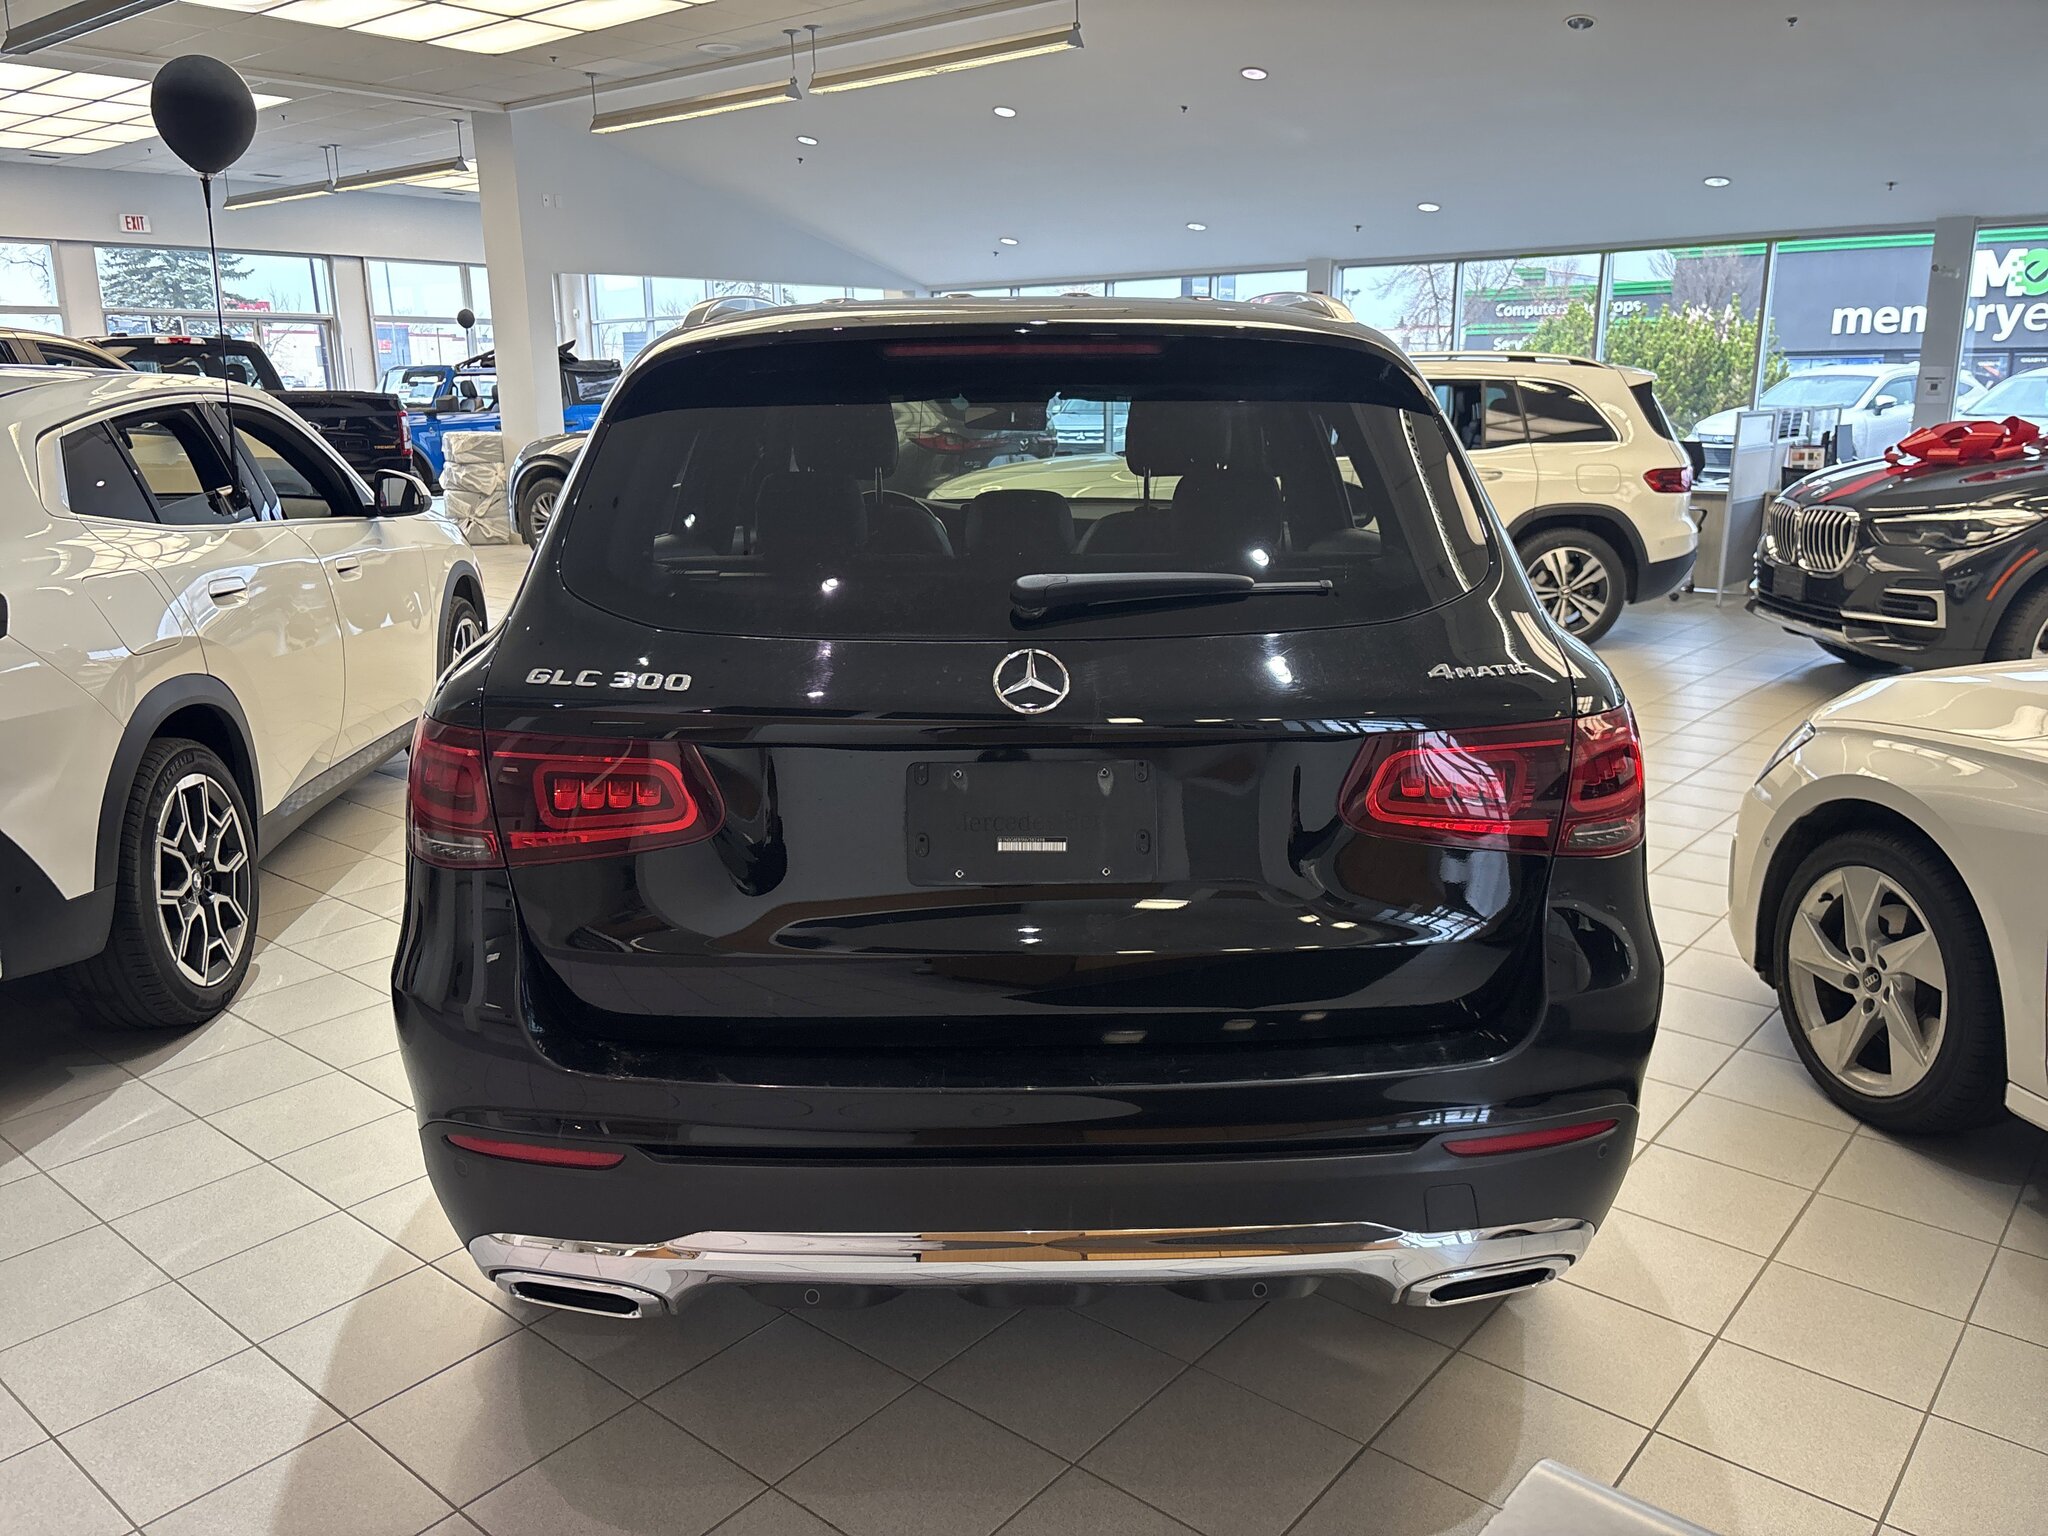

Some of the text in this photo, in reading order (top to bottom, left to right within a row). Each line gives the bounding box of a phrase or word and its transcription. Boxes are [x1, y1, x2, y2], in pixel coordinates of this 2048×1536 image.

[125, 215, 144, 231] EXIT
[1495, 303, 1569, 319] Computers
[1427, 663, 1526, 680] 4MATIC
[525, 668, 692, 692] GLC 300
